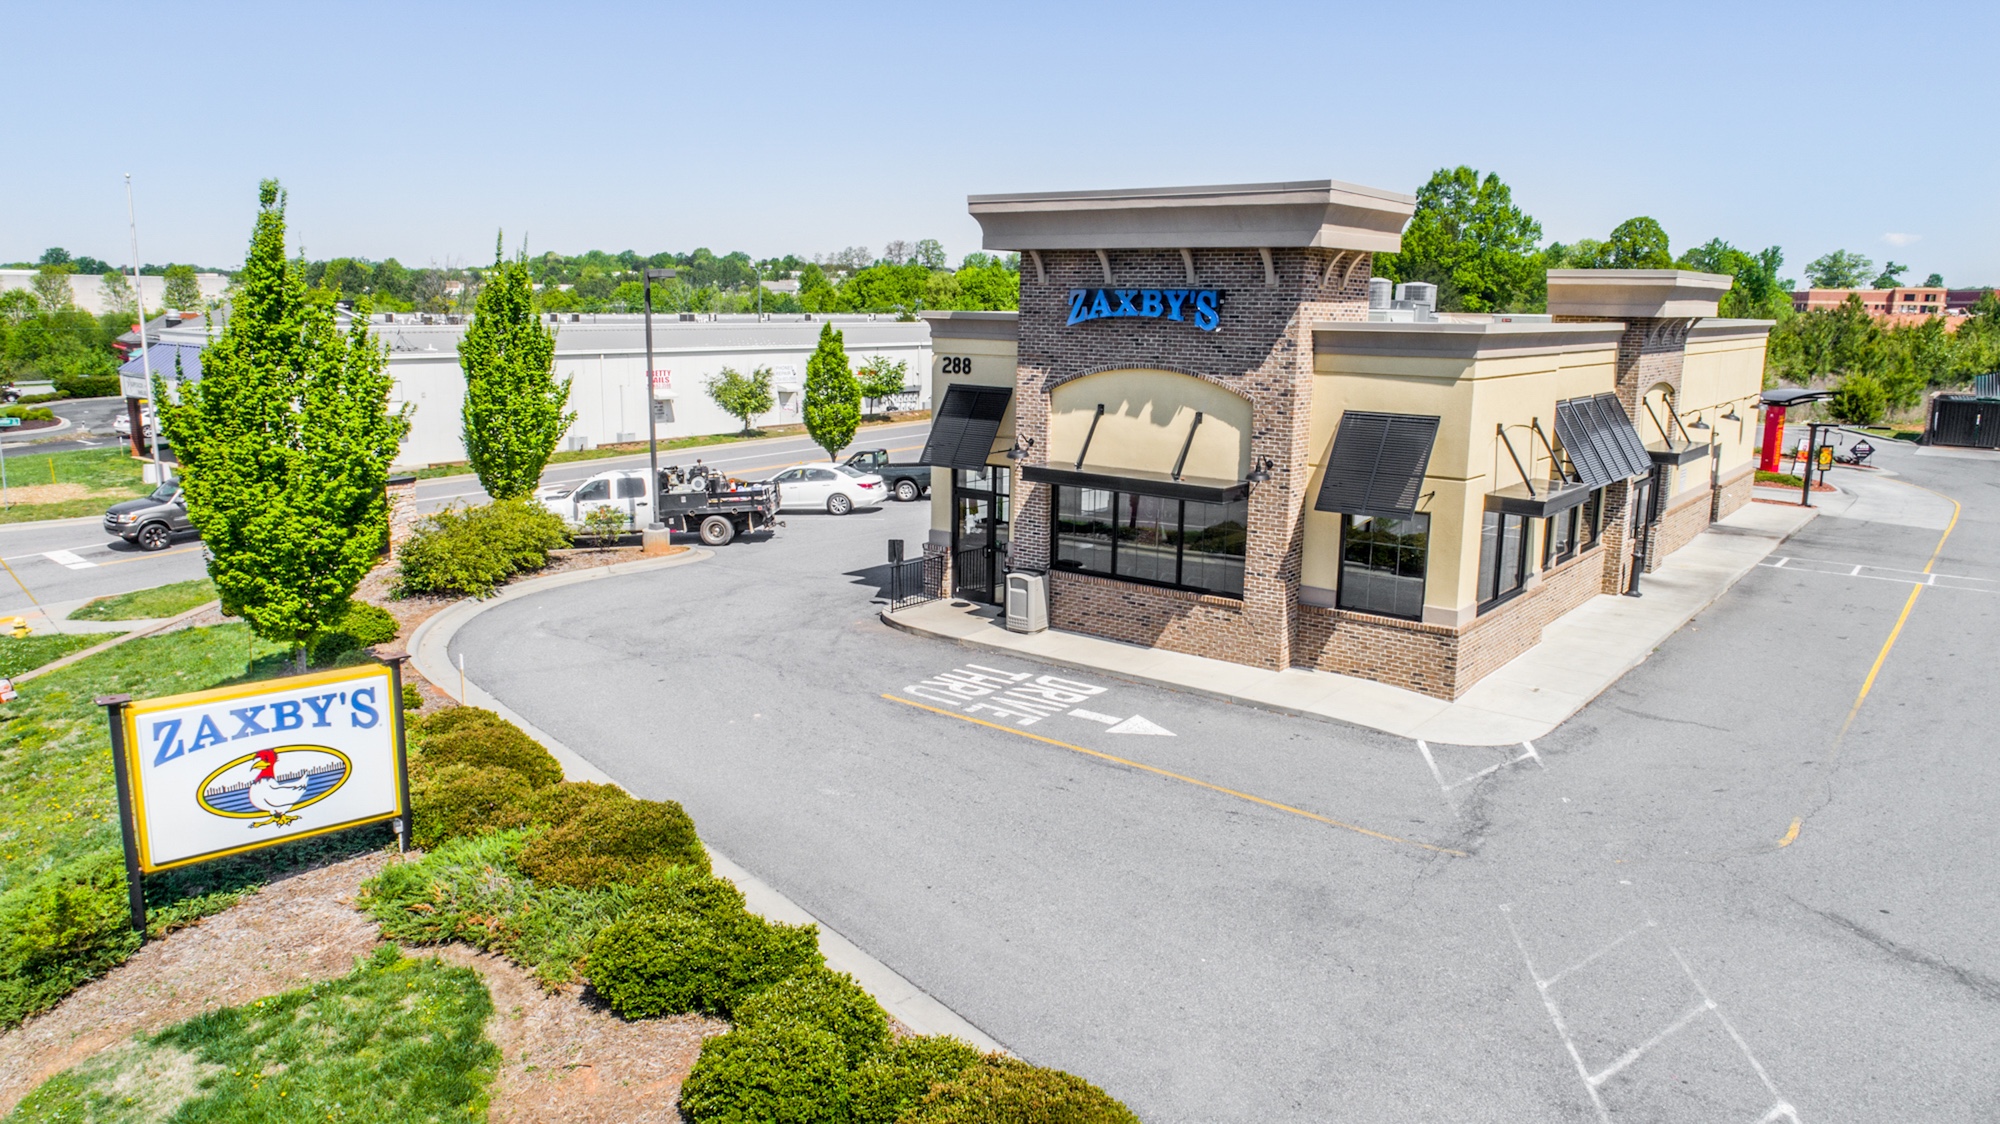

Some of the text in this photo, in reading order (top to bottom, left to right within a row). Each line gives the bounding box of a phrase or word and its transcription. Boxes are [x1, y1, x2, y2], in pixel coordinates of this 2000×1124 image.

[1066, 289, 1221, 332] ZAXBY'S
[942, 356, 972, 375] 288
[903, 663, 1033, 706] THRU
[964, 675, 1108, 726] DRIVE
[153, 686, 380, 768] ZAXBY'S
